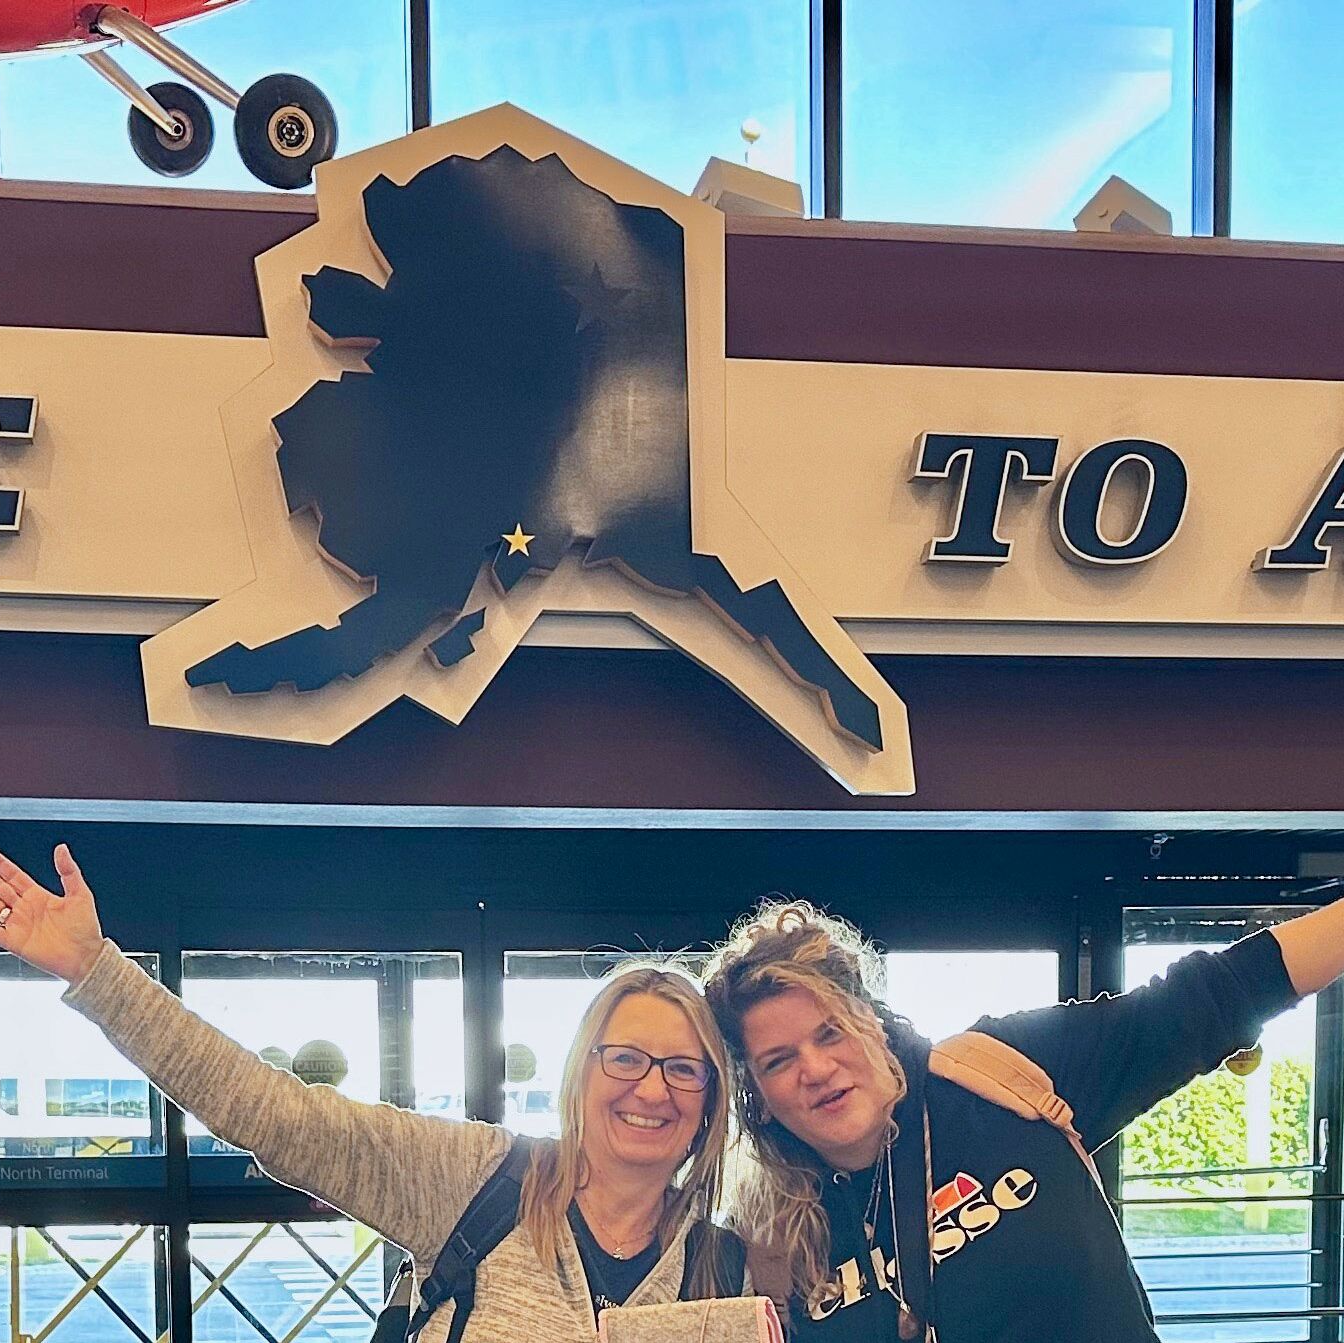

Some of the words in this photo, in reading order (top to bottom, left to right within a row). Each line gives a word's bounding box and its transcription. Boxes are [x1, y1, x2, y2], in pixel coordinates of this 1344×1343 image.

[912, 430, 1190, 567] TO
[0, 1167, 42, 1180] North
[47, 1166, 109, 1180] Terminal
